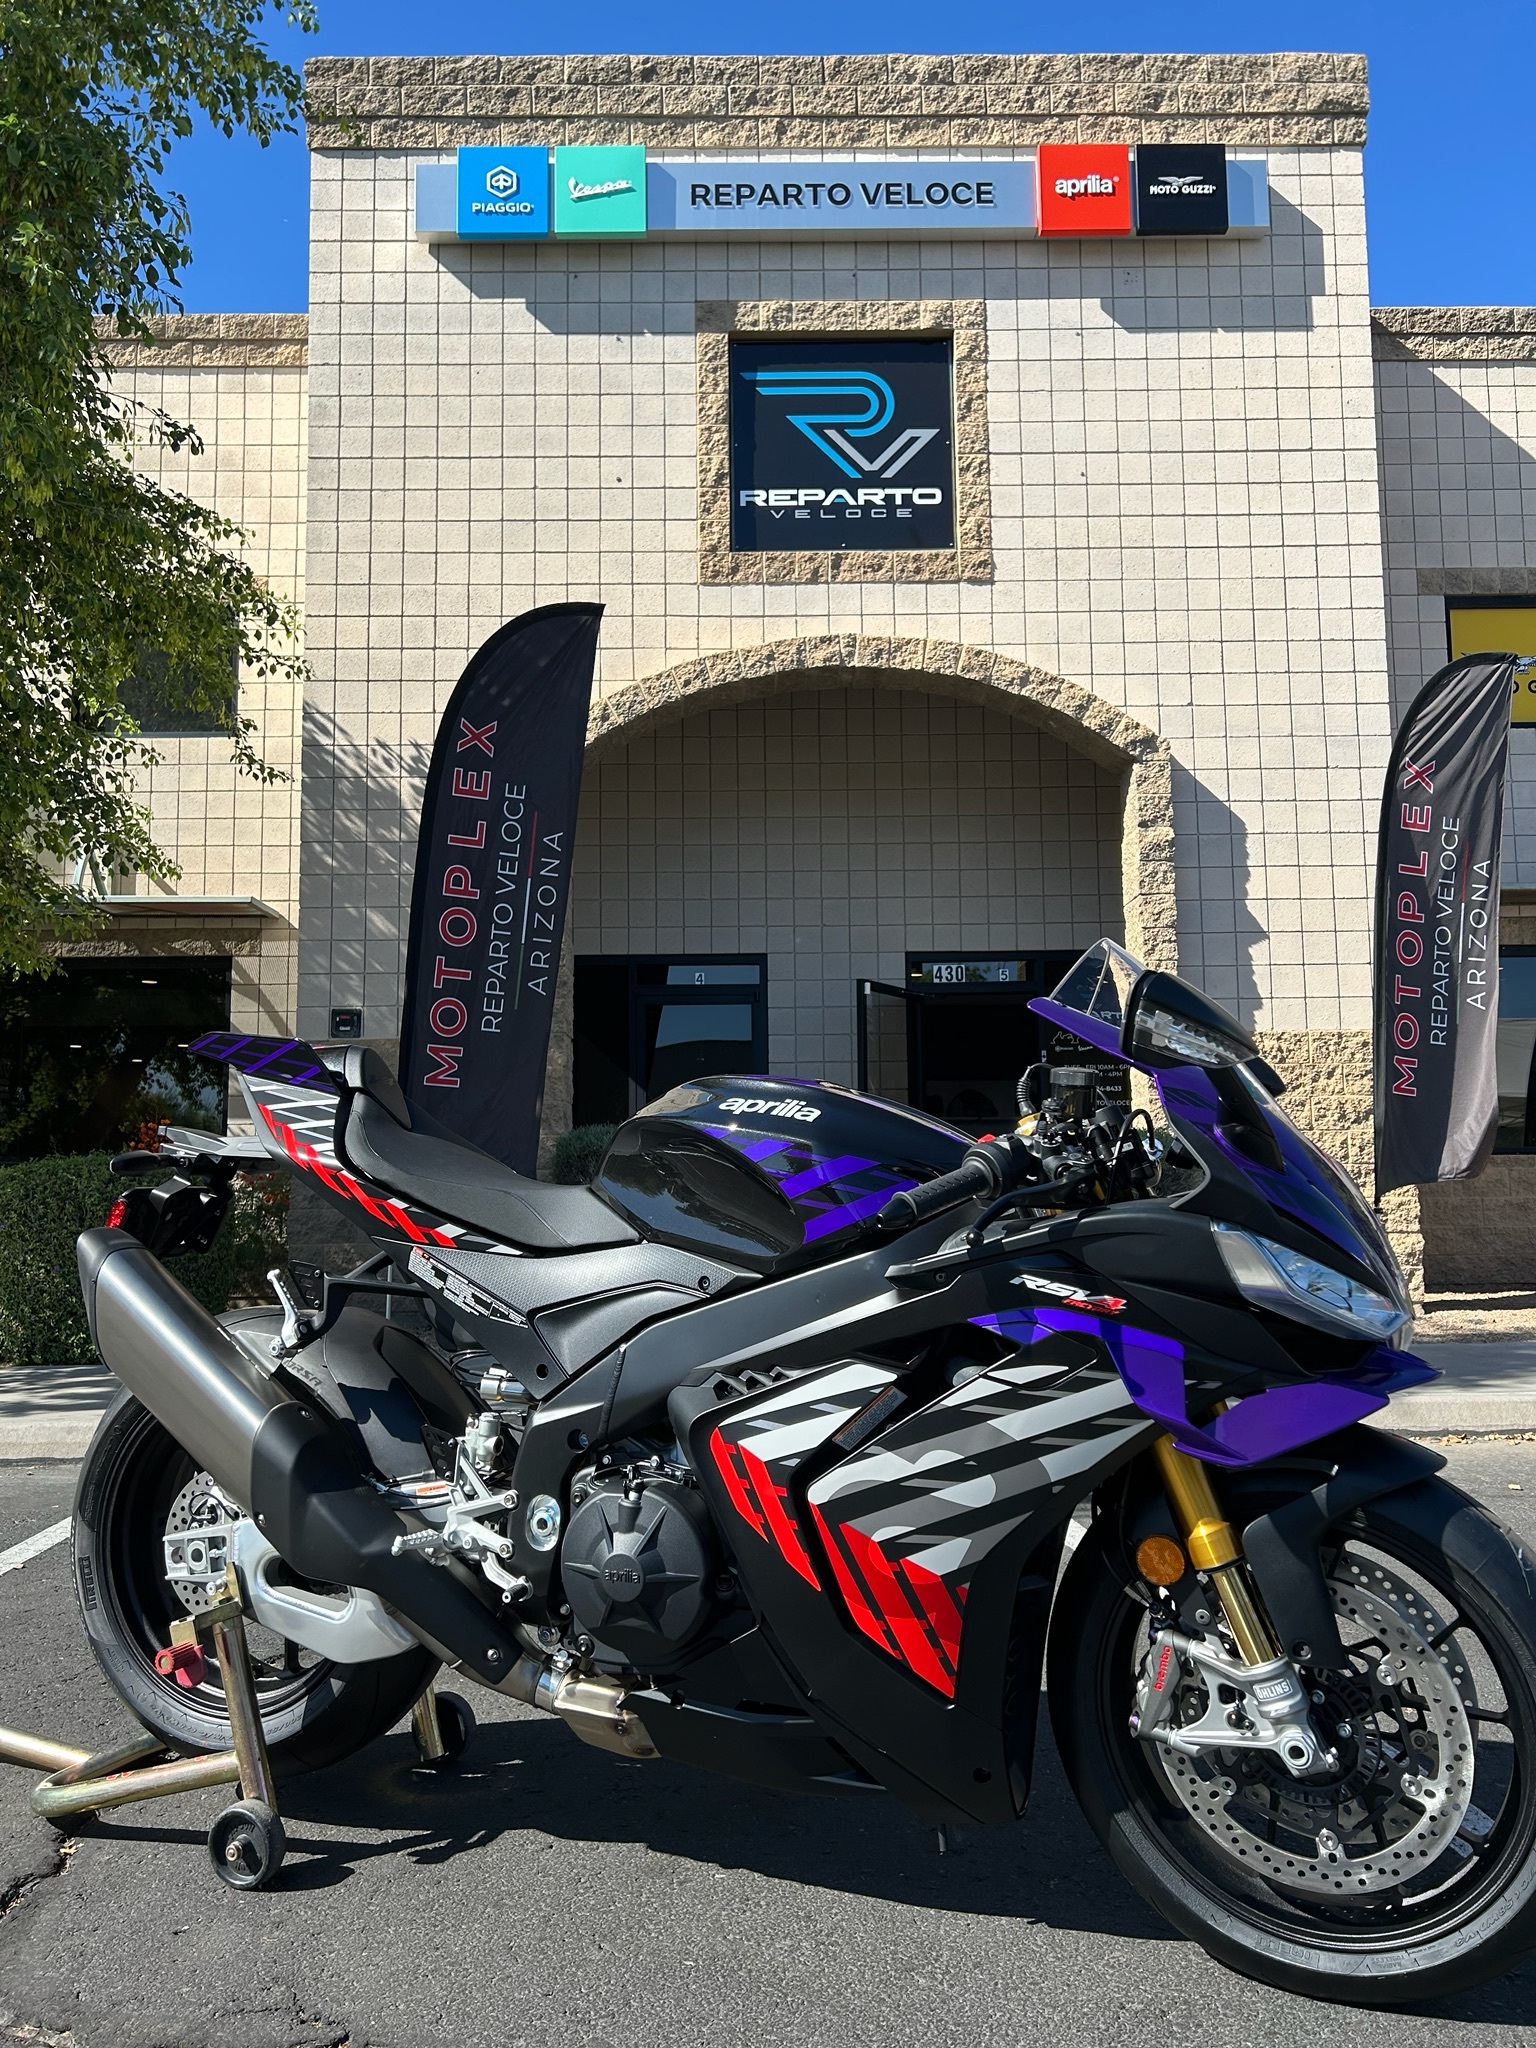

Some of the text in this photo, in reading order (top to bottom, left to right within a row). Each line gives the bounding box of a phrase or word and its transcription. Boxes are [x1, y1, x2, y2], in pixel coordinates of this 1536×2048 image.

[568, 176, 632, 200] Vespa
[691, 182, 995, 206] REPARTO VELOCE
[1055, 175, 1112, 196] aprilia
[1150, 185, 1213, 195] MOTO GUZZI
[472, 202, 531, 213] PIAGGIO
[739, 488, 943, 507] REPARTO
[770, 508, 913, 519] VELOCE
[424, 717, 498, 1088] MOTOPLEX
[481, 783, 526, 1033] REPARTO VELOCE
[528, 831, 564, 997] ARIZONA
[1393, 757, 1437, 1098] MOTOPLEX
[1430, 816, 1461, 1046] REPARTO VELOCE
[1466, 859, 1491, 1011] ARIZONA
[695, 973, 704, 984] 4
[934, 965, 965, 983] 430
[1000, 969, 1009, 981] 5
[718, 1096, 822, 1122] aprilia
[605, 1568, 641, 1584] aprilia
[1153, 1645, 1172, 1692] brembo
